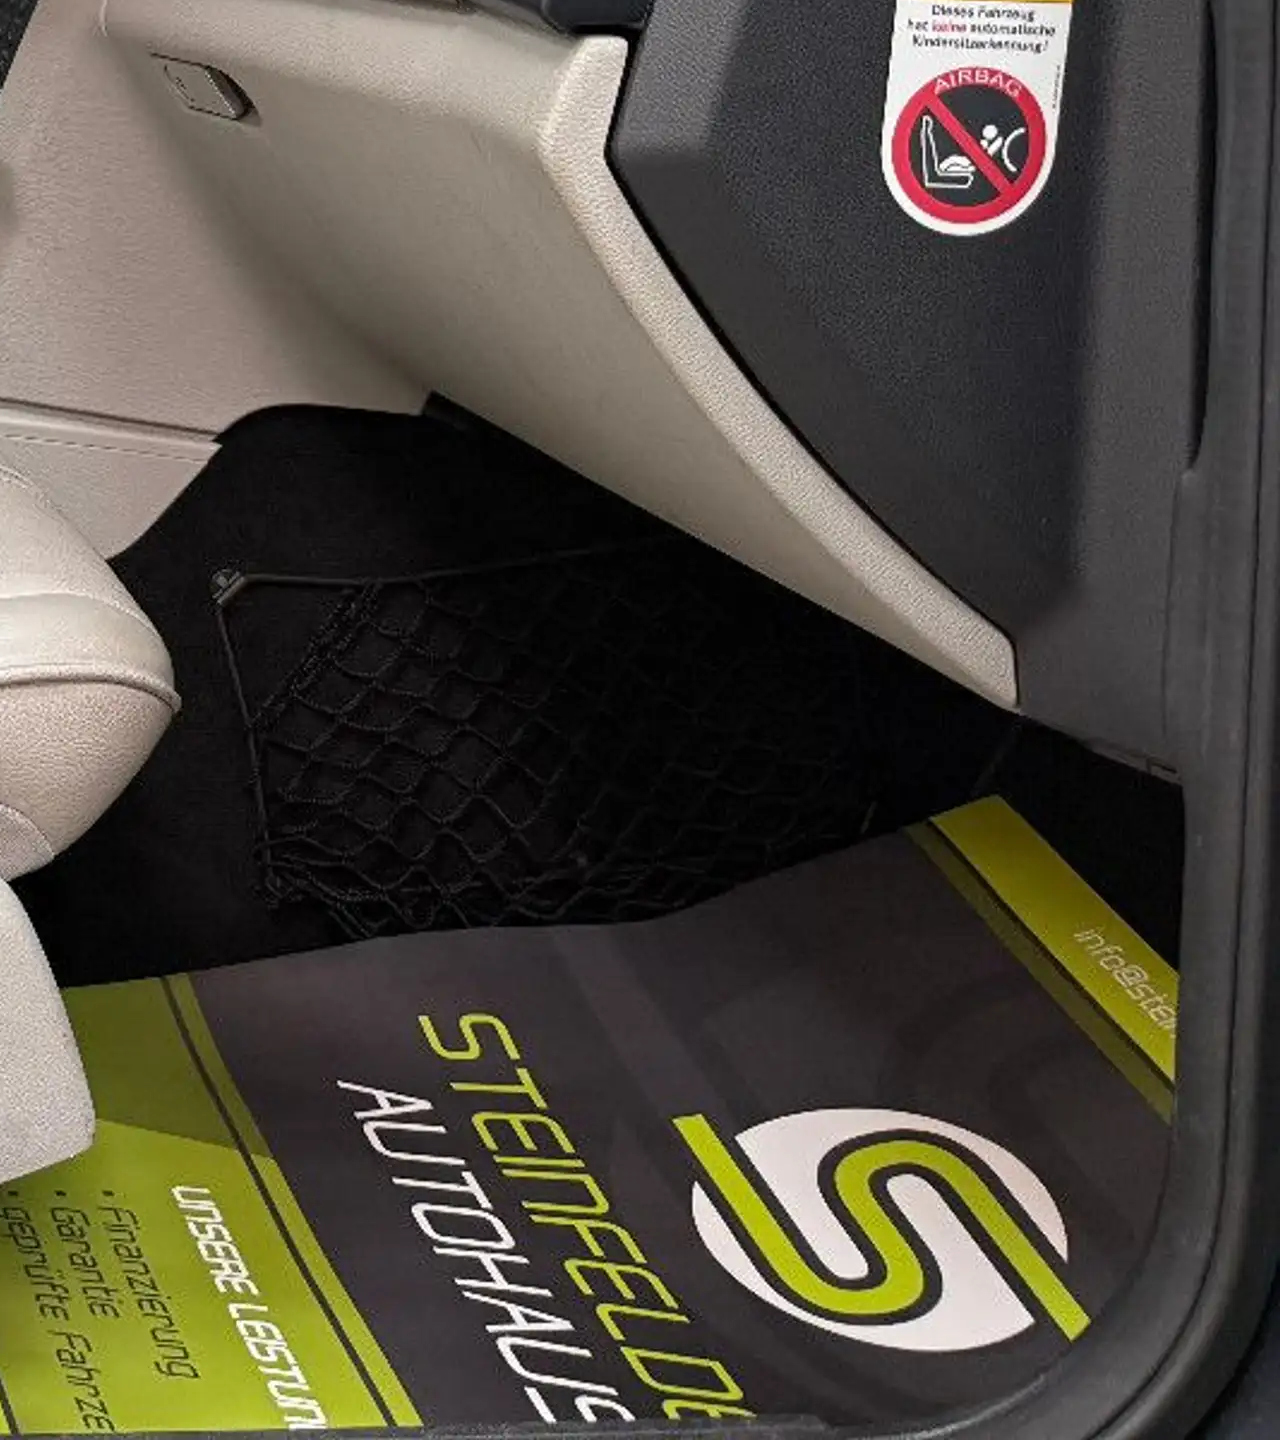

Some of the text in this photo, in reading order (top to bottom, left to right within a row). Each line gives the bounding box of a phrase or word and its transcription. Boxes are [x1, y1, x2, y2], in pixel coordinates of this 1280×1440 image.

[908, 18, 1056, 37] hat keine automatische
[931, 4, 1036, 22] Dieses Fahrzeug
[935, 69, 1022, 98] AIRBAG
[51, 1207, 121, 1320] Garantie
[97, 1205, 201, 1381] Finanzierung
[170, 1184, 328, 1430] UNSERE LEISTUN
